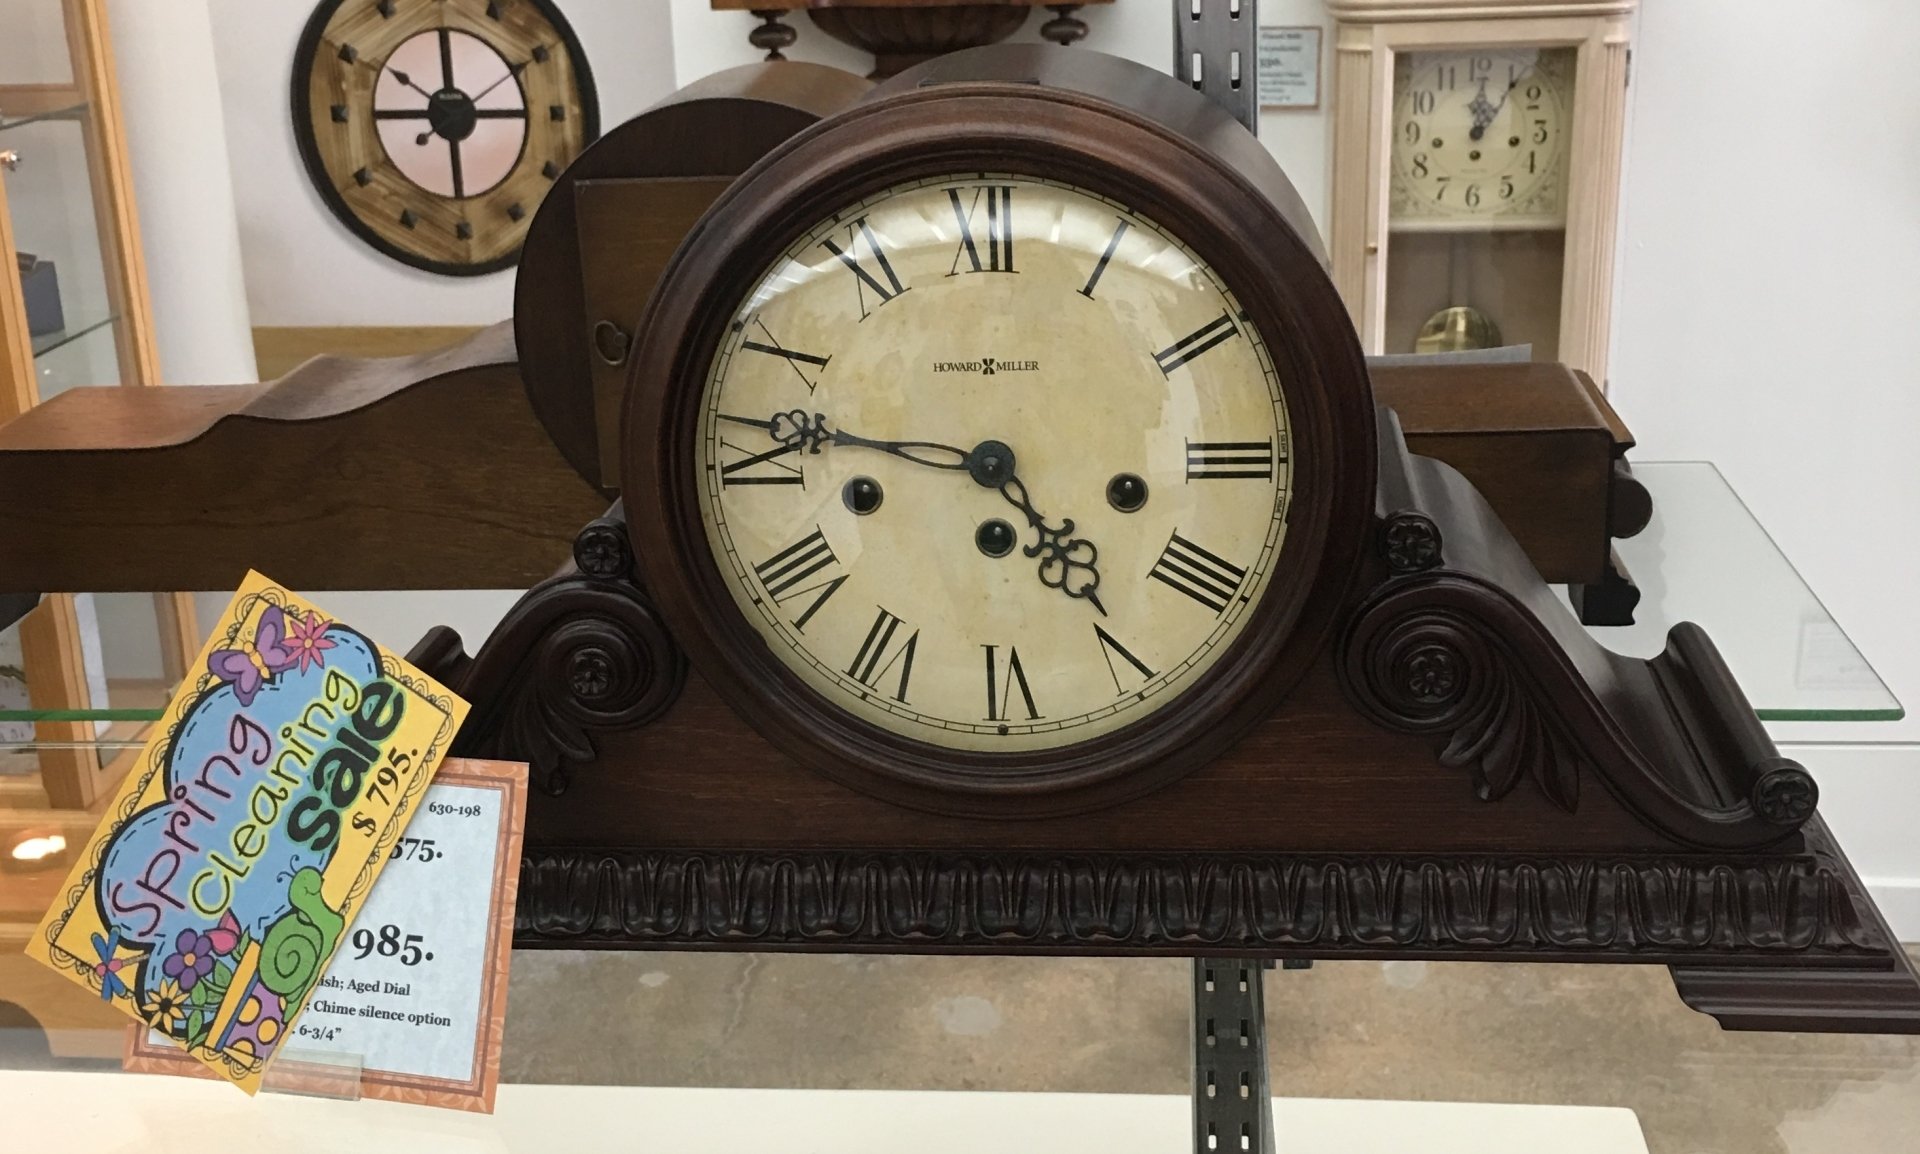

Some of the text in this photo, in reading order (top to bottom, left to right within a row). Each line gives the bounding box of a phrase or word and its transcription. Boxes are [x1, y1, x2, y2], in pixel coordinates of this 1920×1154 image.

[1413, 90, 1435, 115] 10
[1405, 121, 1421, 145] 9
[1533, 119, 1548, 144] 3
[1411, 152, 1428, 179] 8
[1436, 177, 1450, 200] 7
[1499, 175, 1514, 199] 5
[1465, 183, 1480, 208] 6
[944, 186, 1020, 277] XII
[1076, 216, 1137, 300] I
[818, 214, 912, 323] XI
[740, 314, 832, 396] X
[933, 360, 1040, 373] HOWARD MILLER
[1152, 308, 1242, 380] II
[720, 436, 806, 491] IX
[1185, 436, 1273, 484] III
[751, 524, 851, 635] VIII
[1146, 528, 1249, 619] IIII
[842, 605, 920, 705] VII
[980, 644, 1046, 721] VI
[1092, 622, 1160, 696] V
[191, 669, 359, 915] Cleaning
[366, 746, 418, 807] 795.
[112, 713, 272, 937] Spring
[428, 801, 482, 818] 630-198
[352, 924, 434, 967] 985.
[317, 974, 411, 996] ish; Aged Dial
[313, 1000, 357, 1016] Chime
[358, 1005, 405, 1022] silence
[407, 1011, 452, 1027] option
